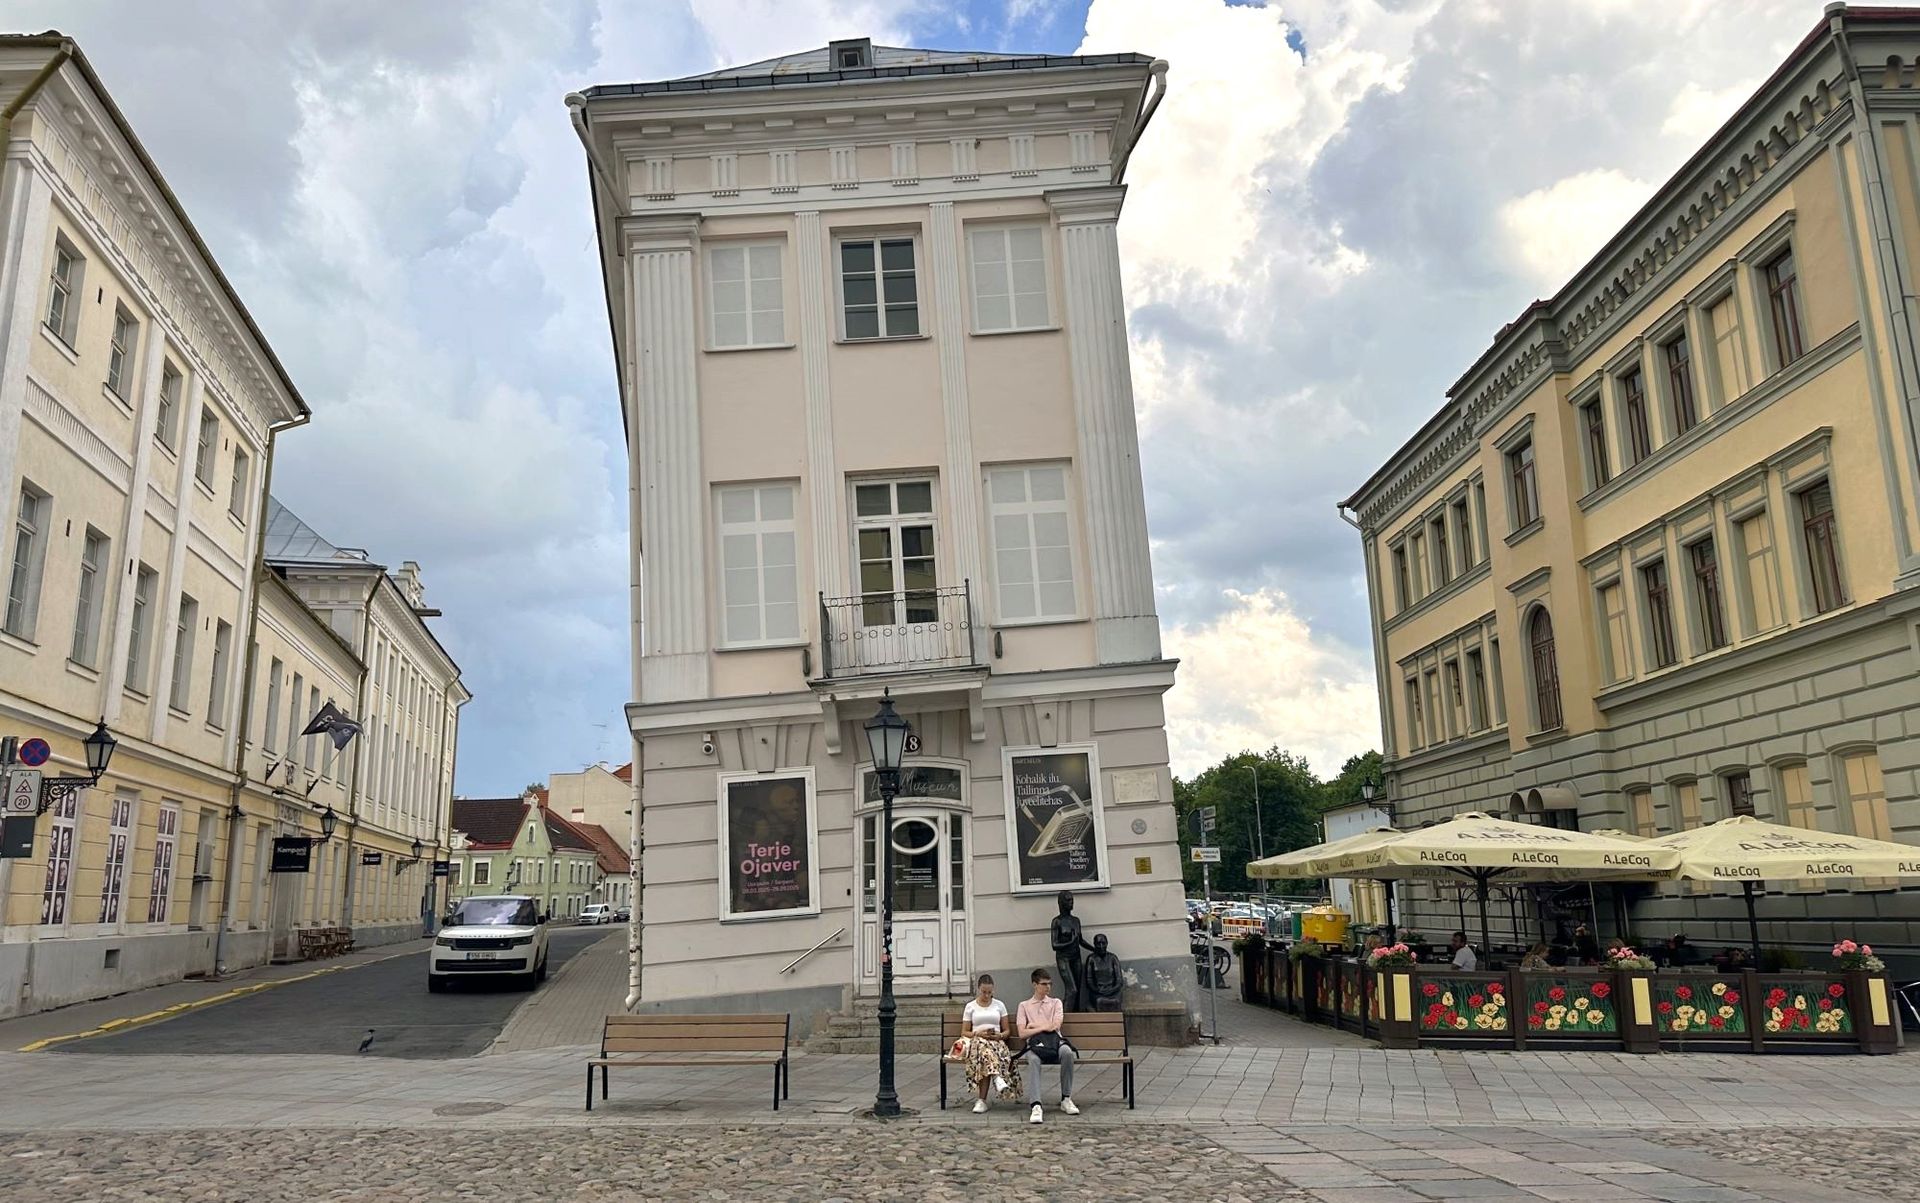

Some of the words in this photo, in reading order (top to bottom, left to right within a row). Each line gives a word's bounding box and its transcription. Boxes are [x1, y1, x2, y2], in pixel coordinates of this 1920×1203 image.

[1015, 773, 1047, 785] Kohalik
[1016, 784, 1051, 796] Tallinna
[18, 798, 28, 807] 20
[748, 841, 791, 860] Terje
[1420, 851, 1467, 864] A.LeCoq
[1512, 852, 1559, 865] A.LeCoq
[1603, 854, 1650, 867] A.LeCoq
[740, 859, 800, 878] Ojaver
[1713, 866, 1760, 878] A.LeCoq
[1806, 863, 1853, 875] A.LeCoq
